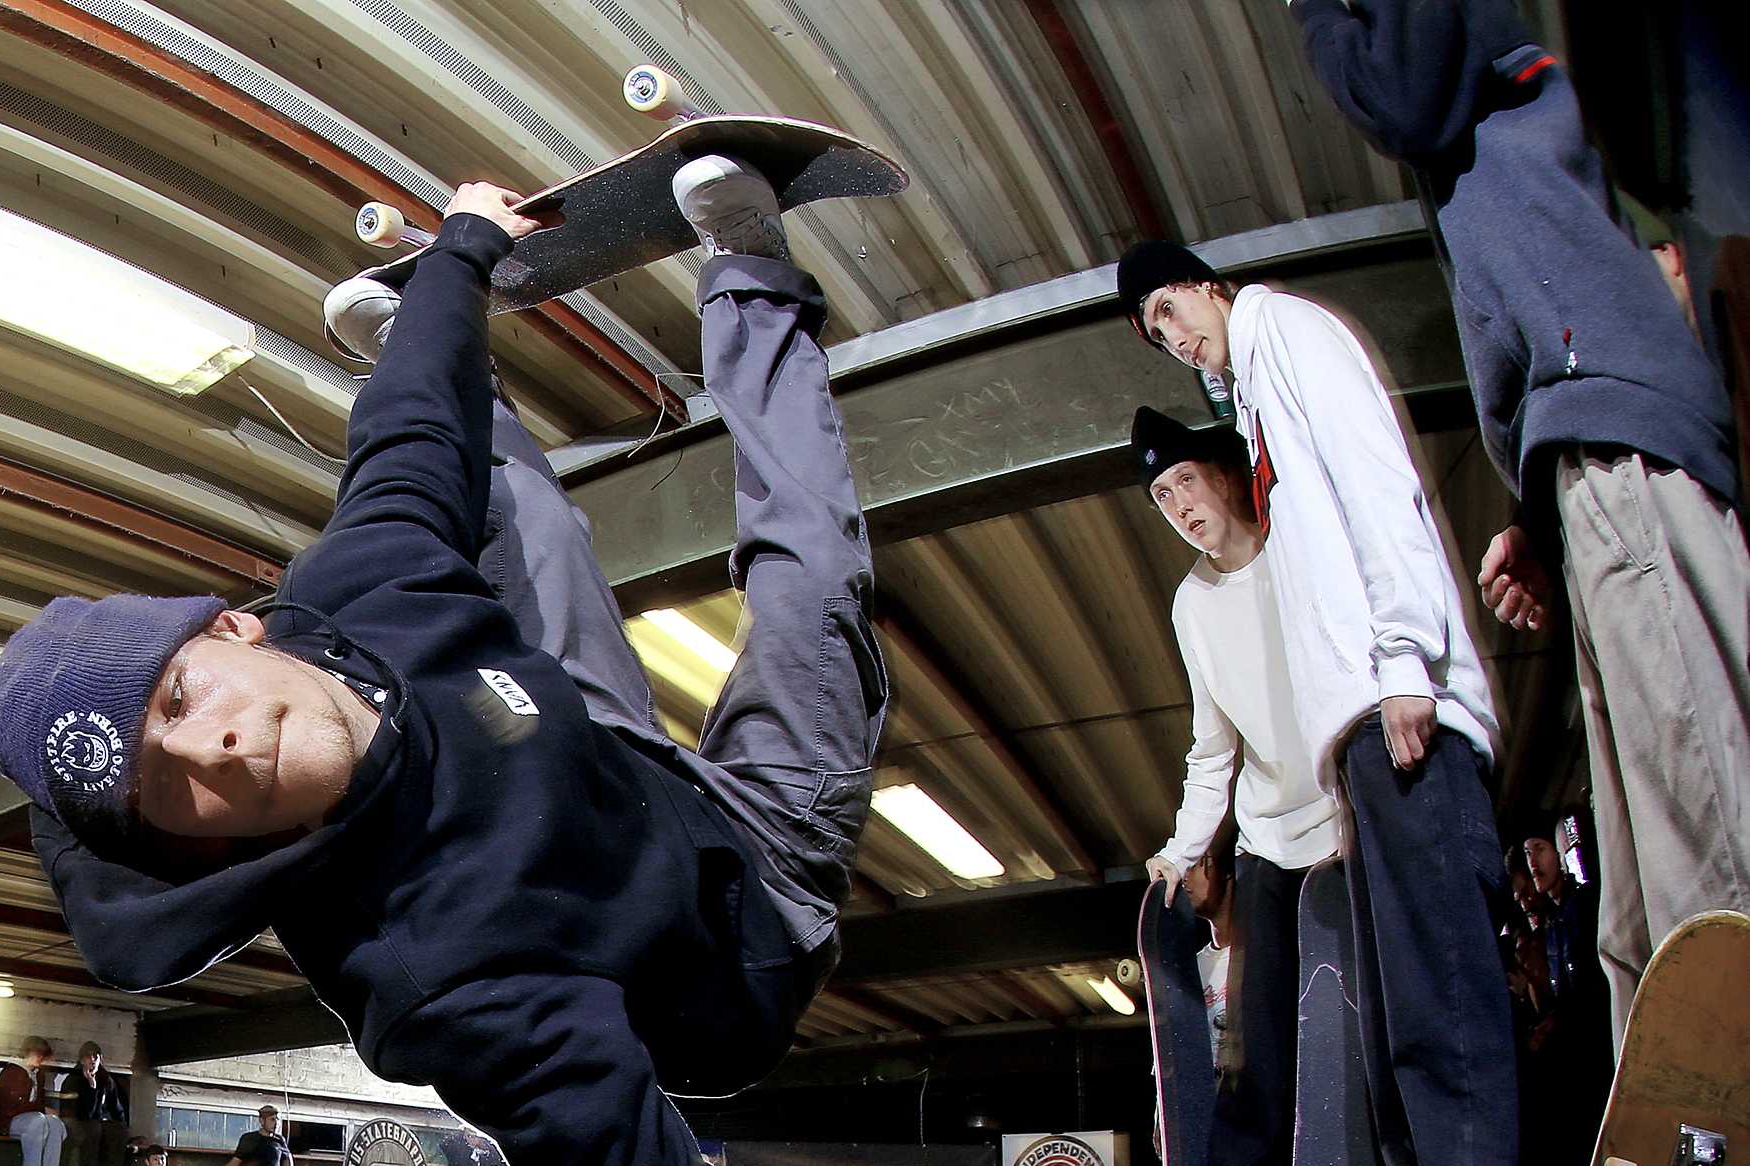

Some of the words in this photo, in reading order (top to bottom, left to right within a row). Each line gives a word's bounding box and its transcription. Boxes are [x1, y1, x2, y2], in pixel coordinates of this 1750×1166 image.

[46, 710, 78, 781] SPITFIRE
[87, 711, 123, 752] BURN
[110, 755, 123, 776] TO
[84, 775, 115, 791] LIVE
